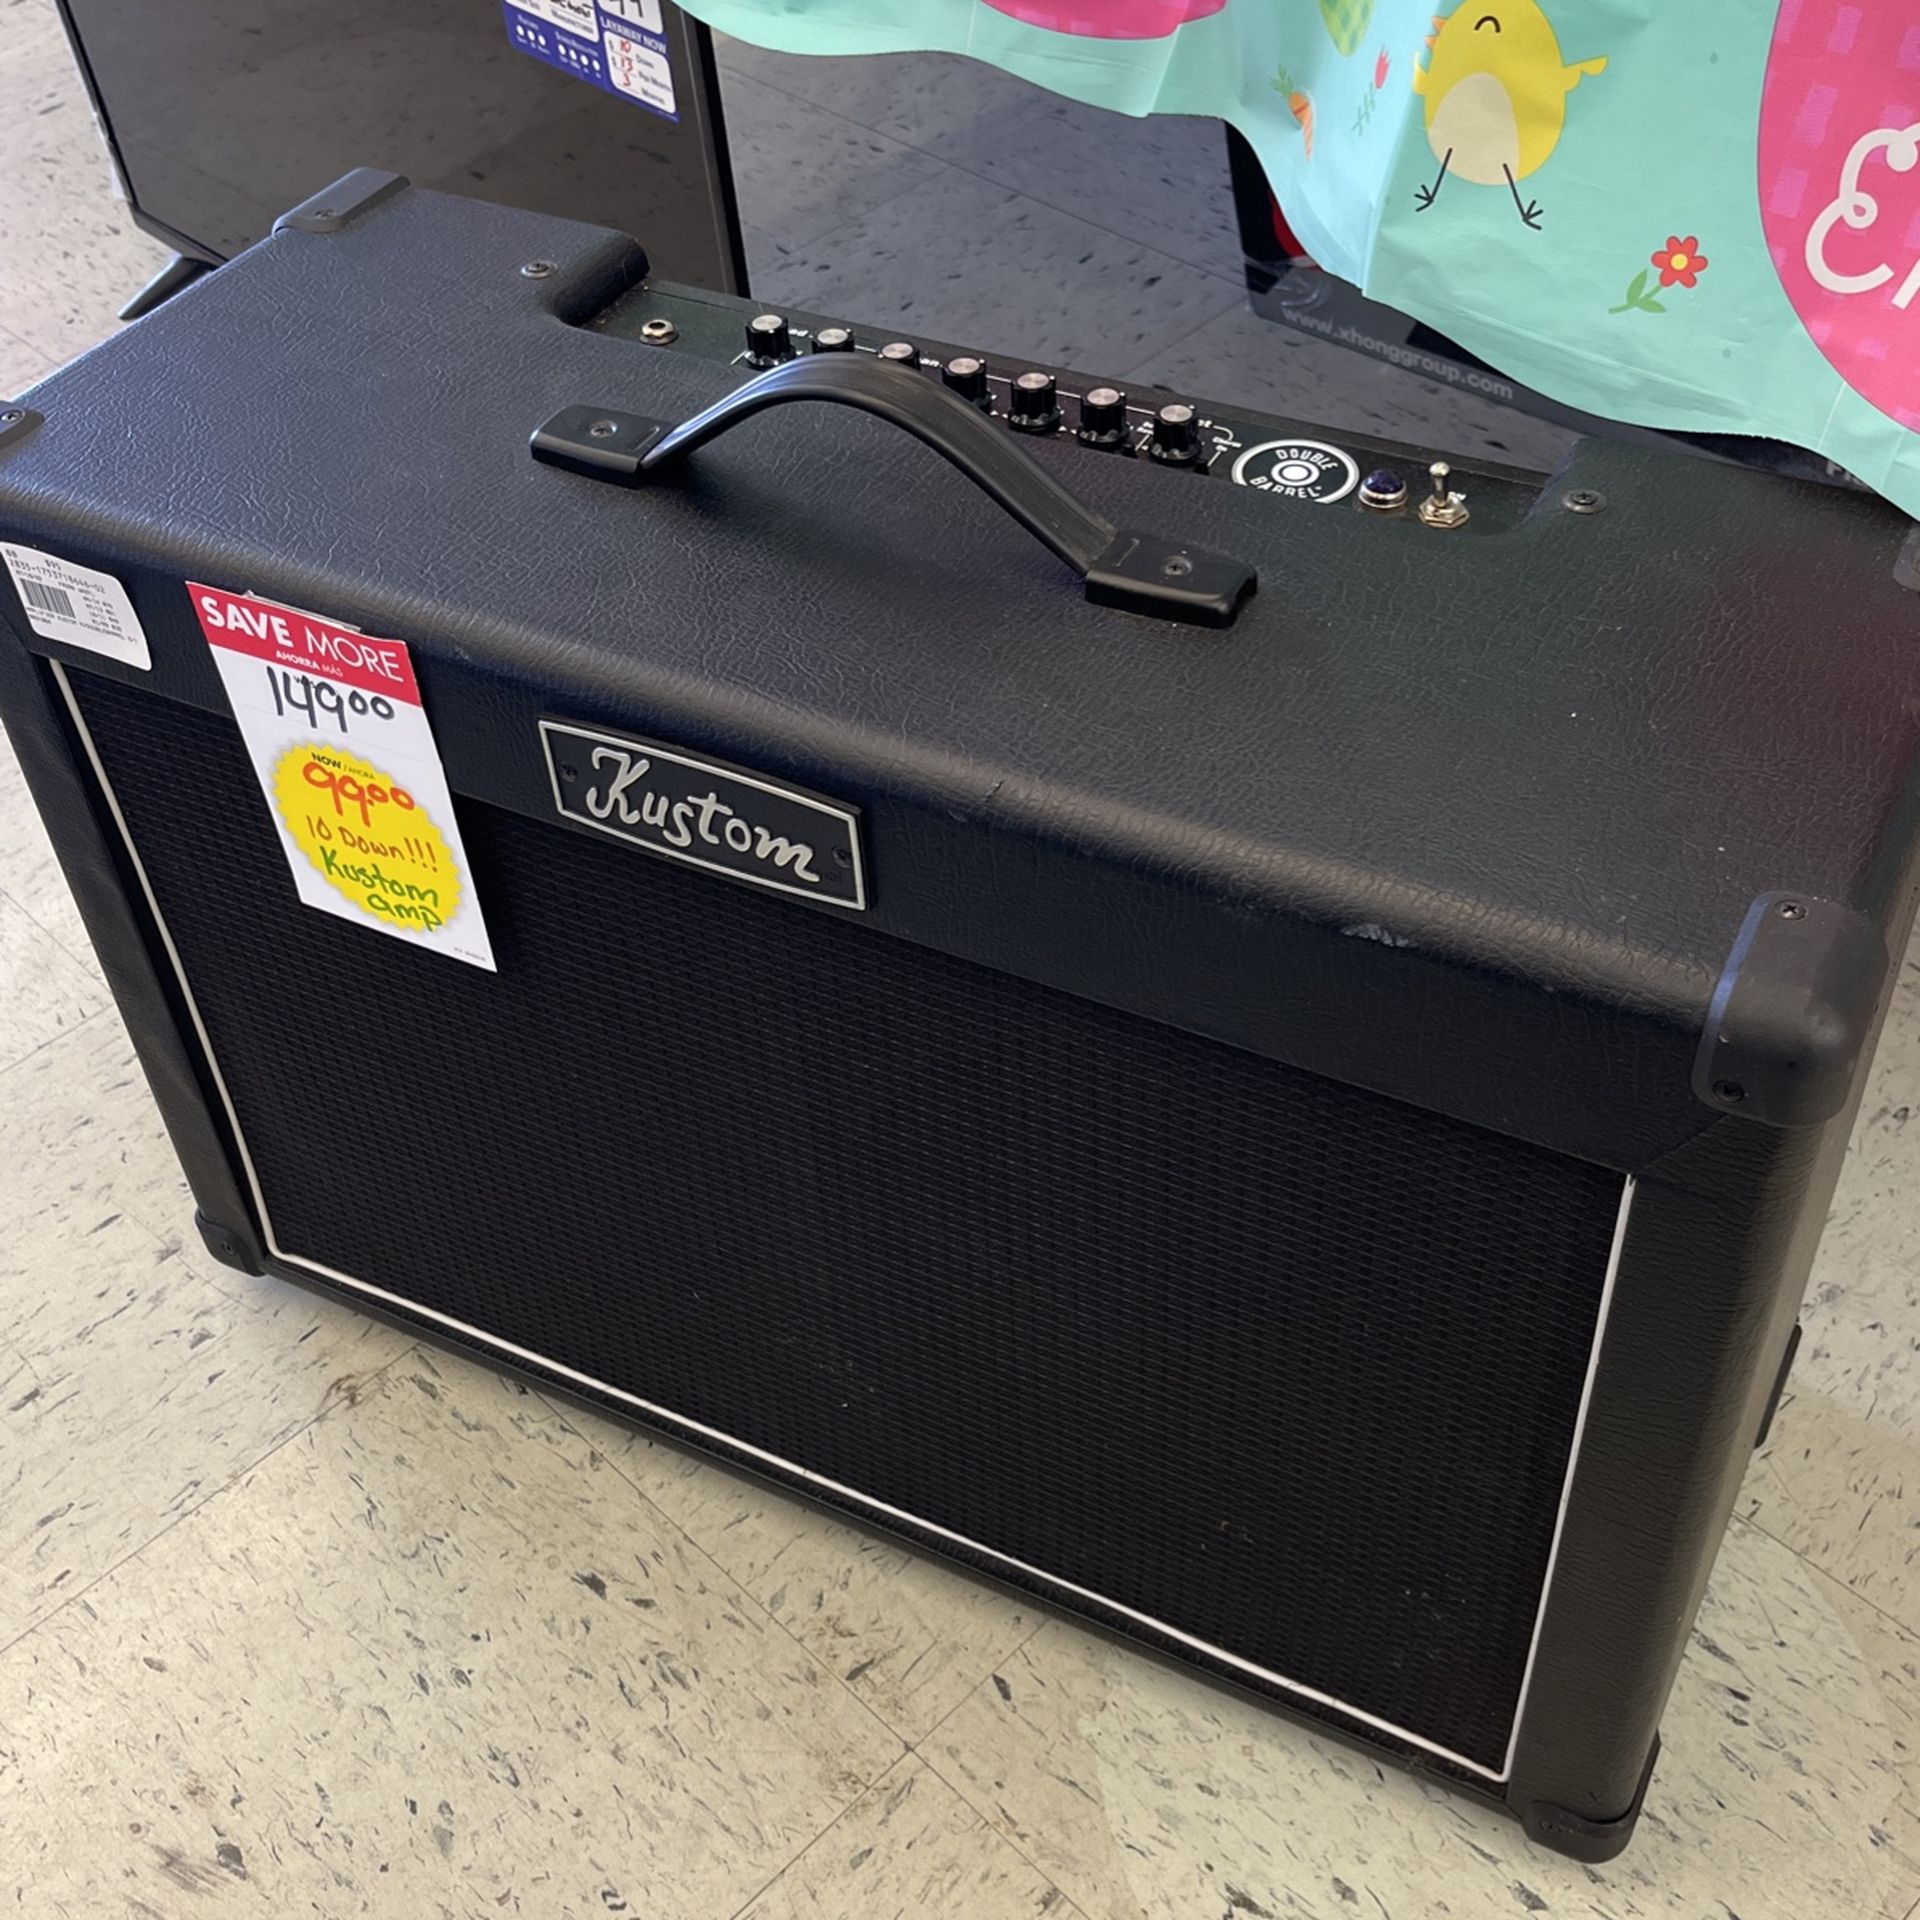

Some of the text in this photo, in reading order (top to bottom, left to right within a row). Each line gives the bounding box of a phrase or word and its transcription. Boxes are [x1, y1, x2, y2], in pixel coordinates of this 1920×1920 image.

[643, 34, 667, 54] NOW
[1805, 122, 1920, 311] E
[1275, 448, 1338, 471] DOUBLE
[201, 596, 294, 648] SAVE
[304, 626, 404, 682] MORE
[276, 650, 320, 671] AHORRA
[312, 752, 341, 769] NOW
[306, 814, 332, 841] 10
[586, 746, 820, 882] Kustom
[320, 845, 439, 907] Kustom
